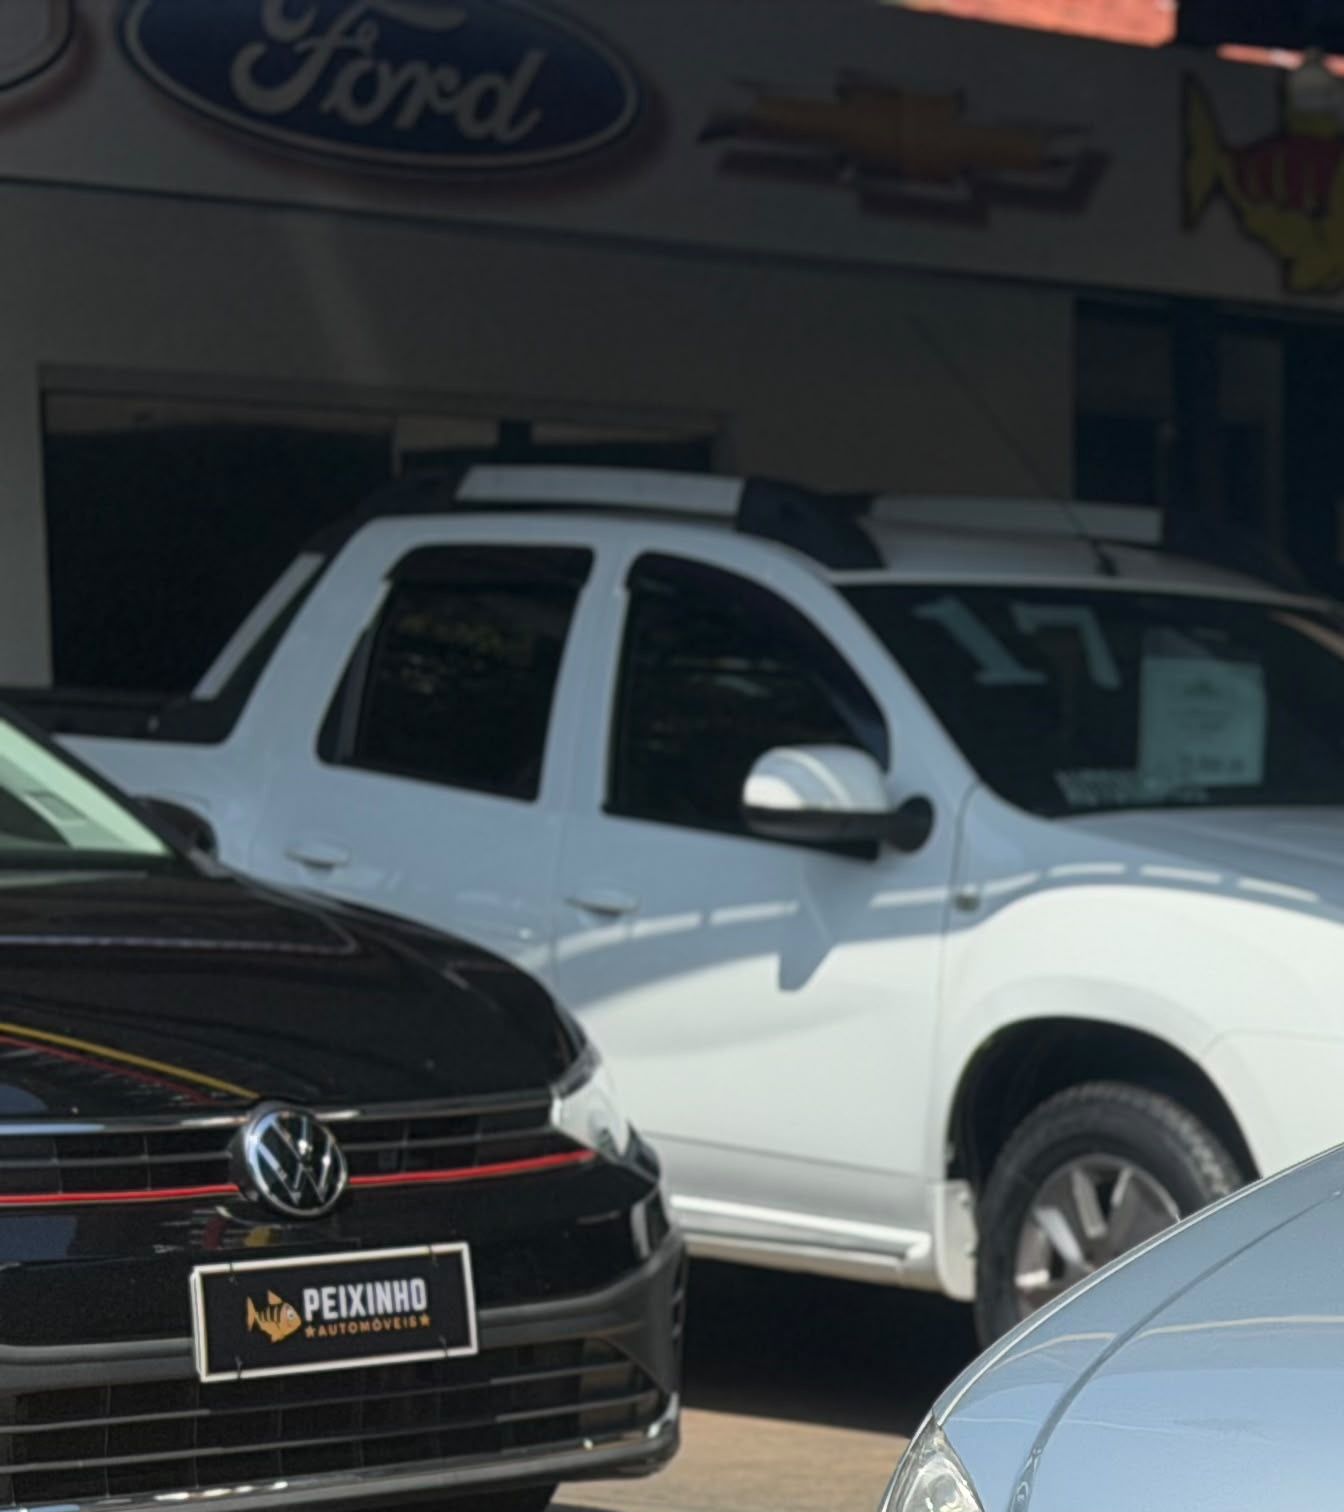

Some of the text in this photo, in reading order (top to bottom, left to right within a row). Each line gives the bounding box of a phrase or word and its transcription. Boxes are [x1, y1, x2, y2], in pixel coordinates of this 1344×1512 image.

[229, 0, 544, 142] Ford
[303, 1278, 428, 1320] PEIXINHO
[318, 1317, 419, 1337] AUTOMÓVEIS
